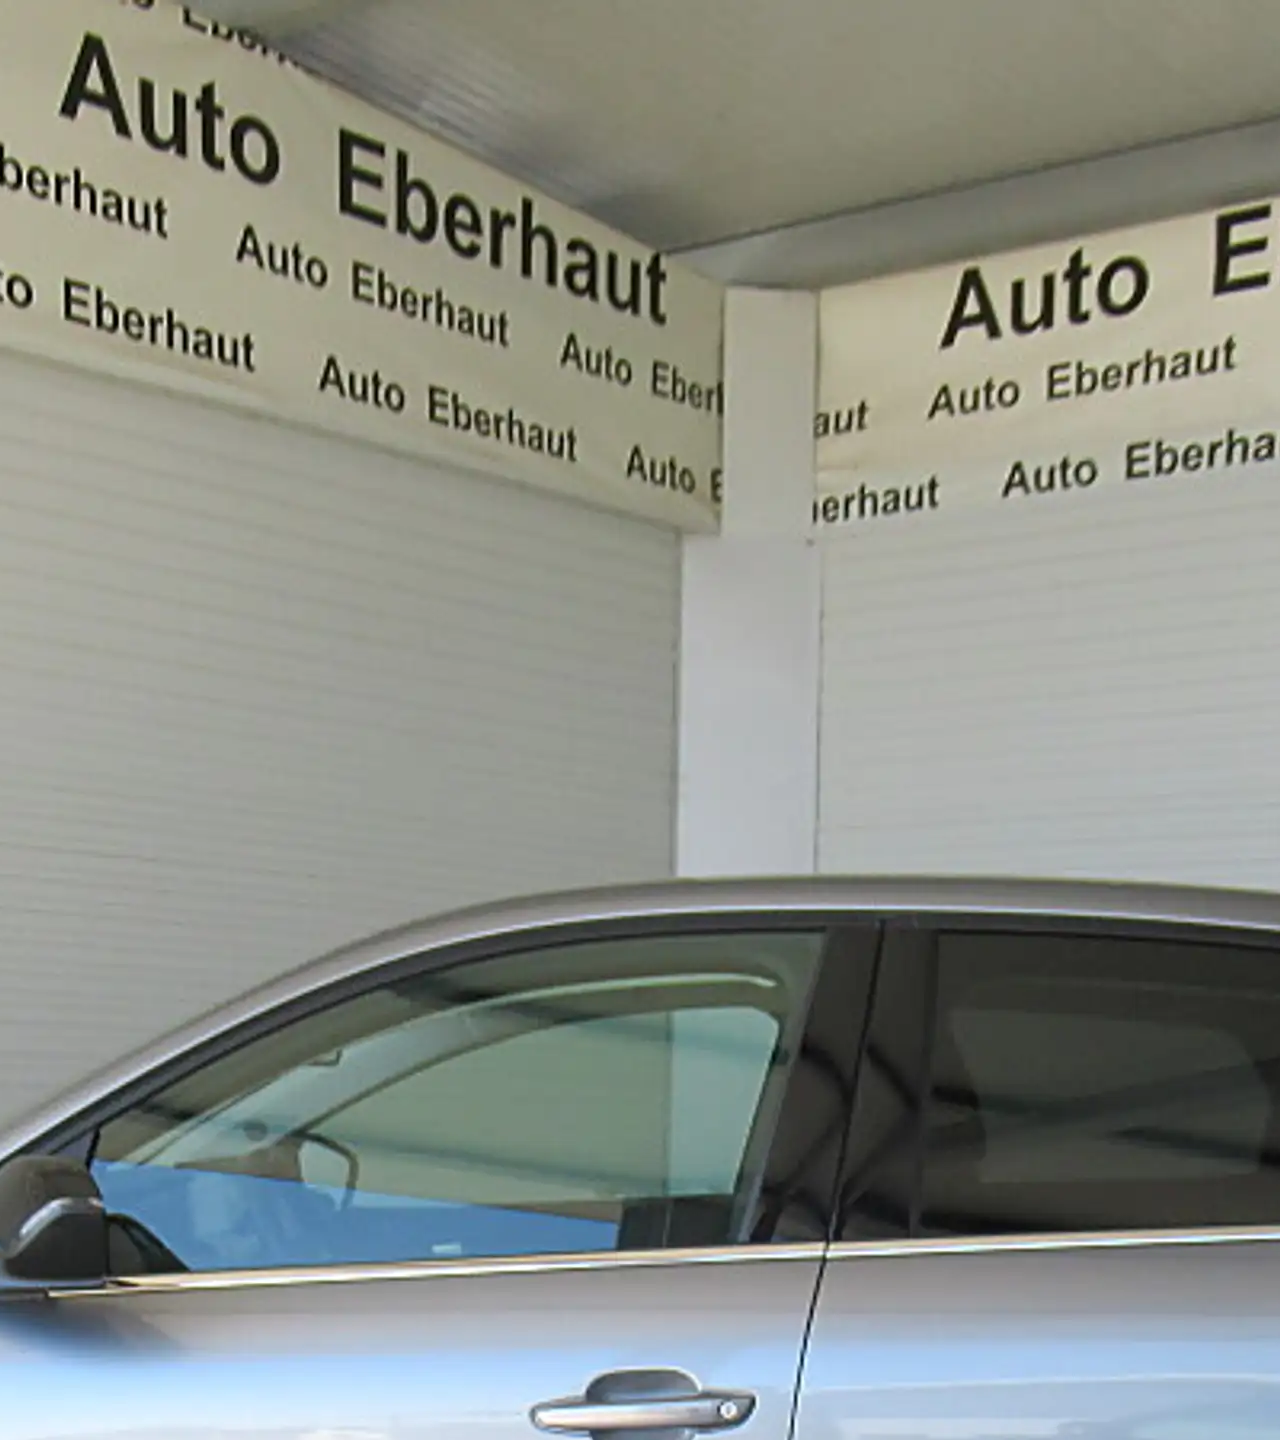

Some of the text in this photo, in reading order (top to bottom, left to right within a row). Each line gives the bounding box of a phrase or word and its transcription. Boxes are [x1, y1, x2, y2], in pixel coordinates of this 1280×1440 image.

[58, 31, 667, 327] Auto Eberhaut
[63, 276, 255, 374] Eberhaut
[235, 224, 510, 349] Auto Eberhaut
[939, 234, 1150, 350] Auto
[560, 332, 633, 387] Auto
[927, 336, 1237, 420] Auto Eberhaut
[319, 355, 578, 464] Auto Eberhaut
[626, 444, 696, 494] Auto
[1001, 455, 1099, 499] Auto
